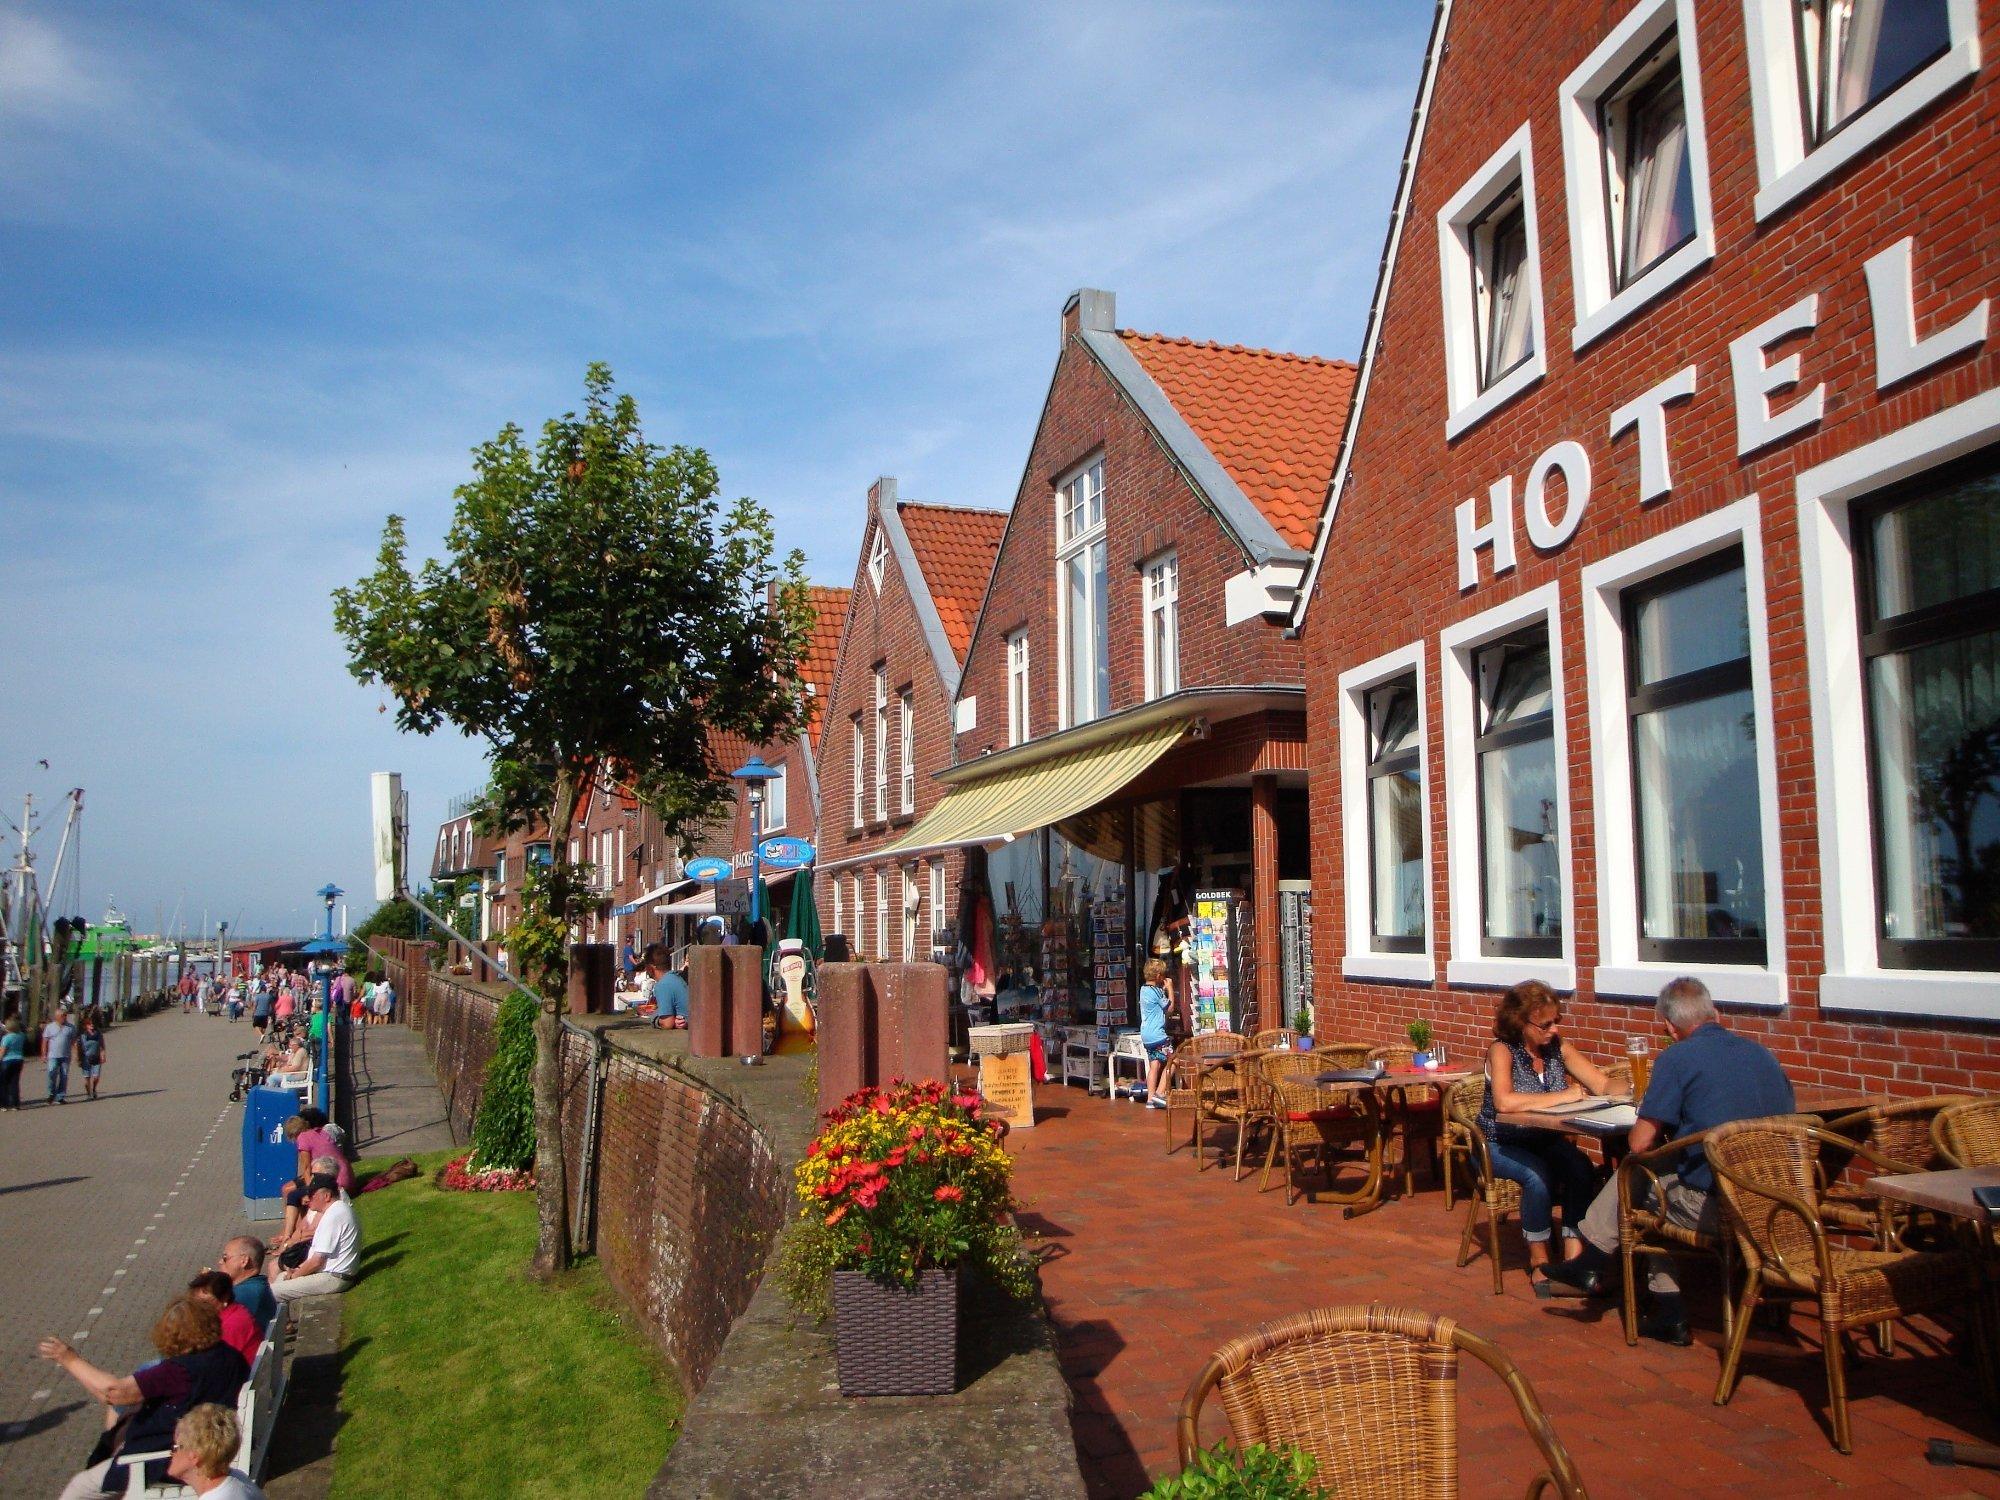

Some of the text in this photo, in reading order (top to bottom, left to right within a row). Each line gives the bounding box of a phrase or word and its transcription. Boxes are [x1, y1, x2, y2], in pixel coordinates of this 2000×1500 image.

[1455, 235, 1990, 593] HOTEL
[781, 843, 811, 858] EIS
[1195, 891, 1232, 899] GOLDBEK
